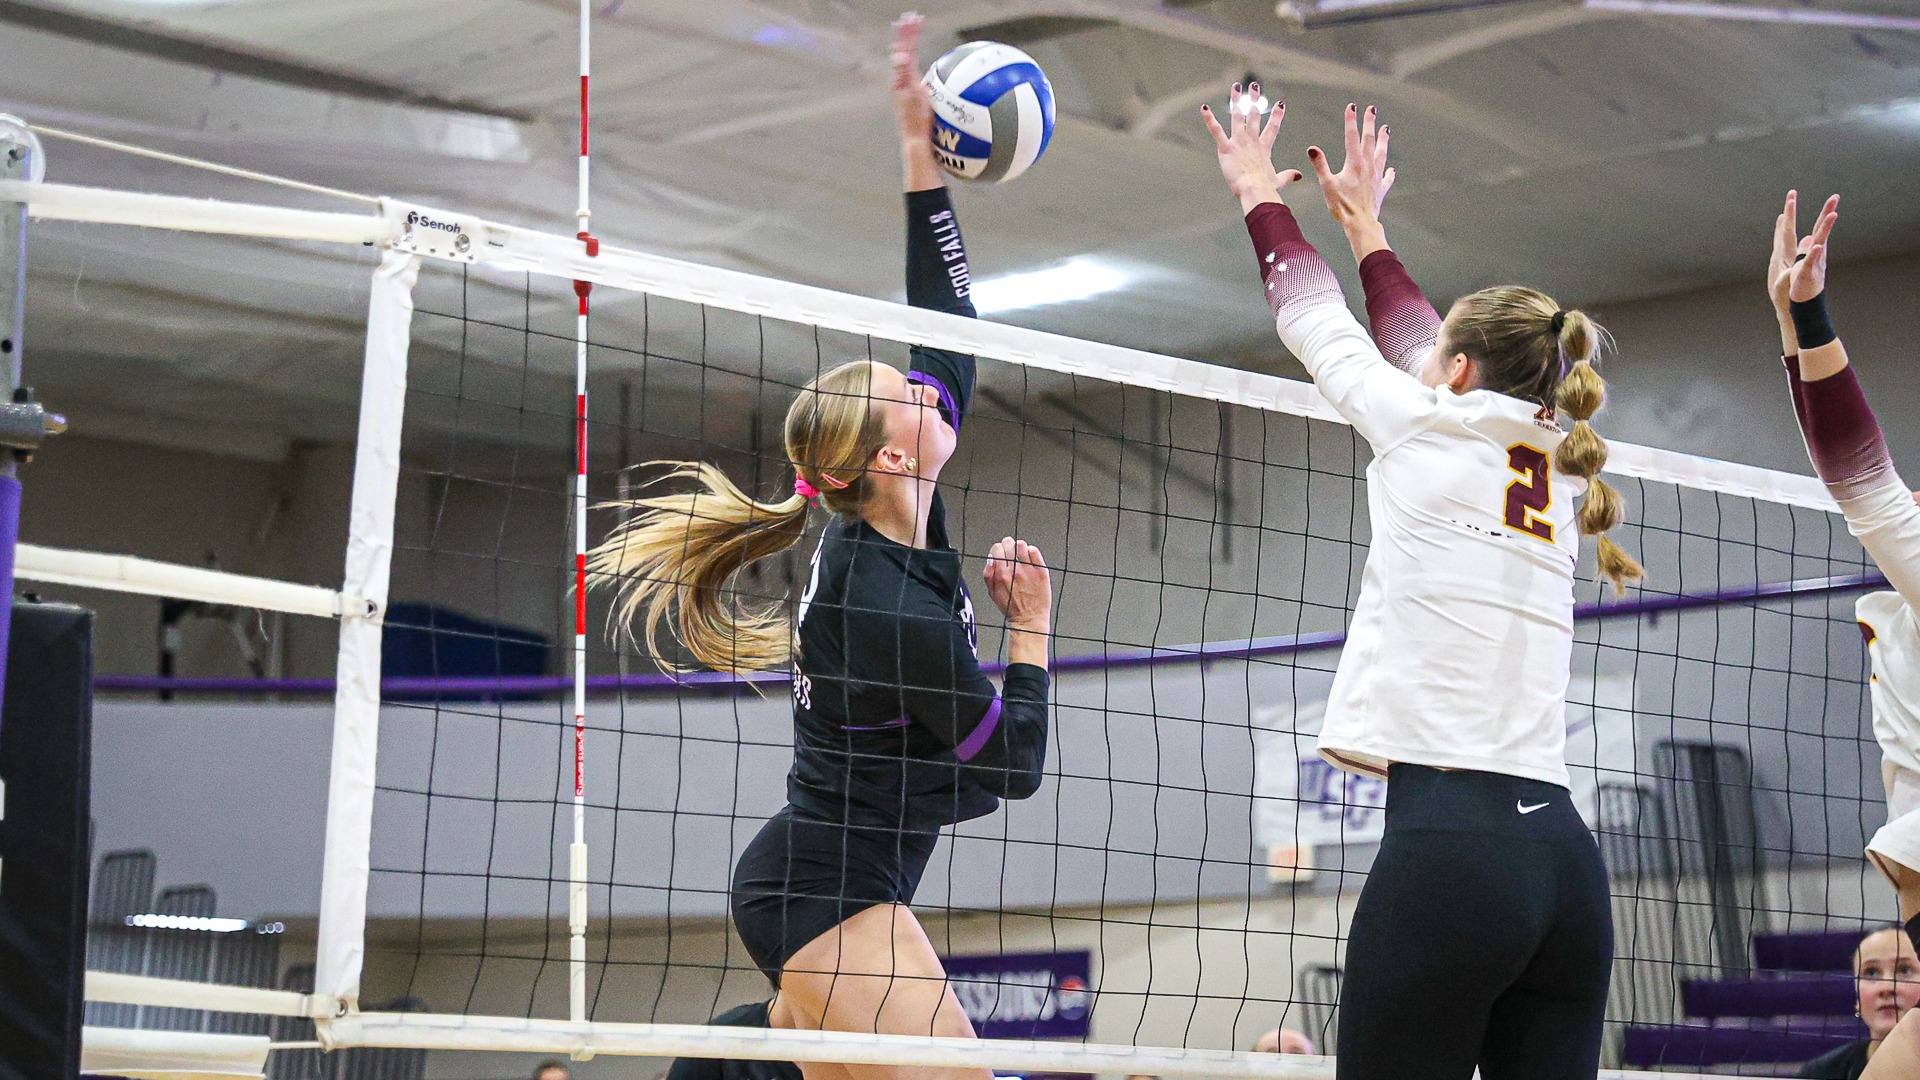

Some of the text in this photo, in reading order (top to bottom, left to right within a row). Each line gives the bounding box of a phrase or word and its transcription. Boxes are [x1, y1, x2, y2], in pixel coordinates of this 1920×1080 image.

[420, 215, 461, 234] Senoh
[929, 210, 965, 262] FALLS
[1503, 442, 1555, 544] 2
